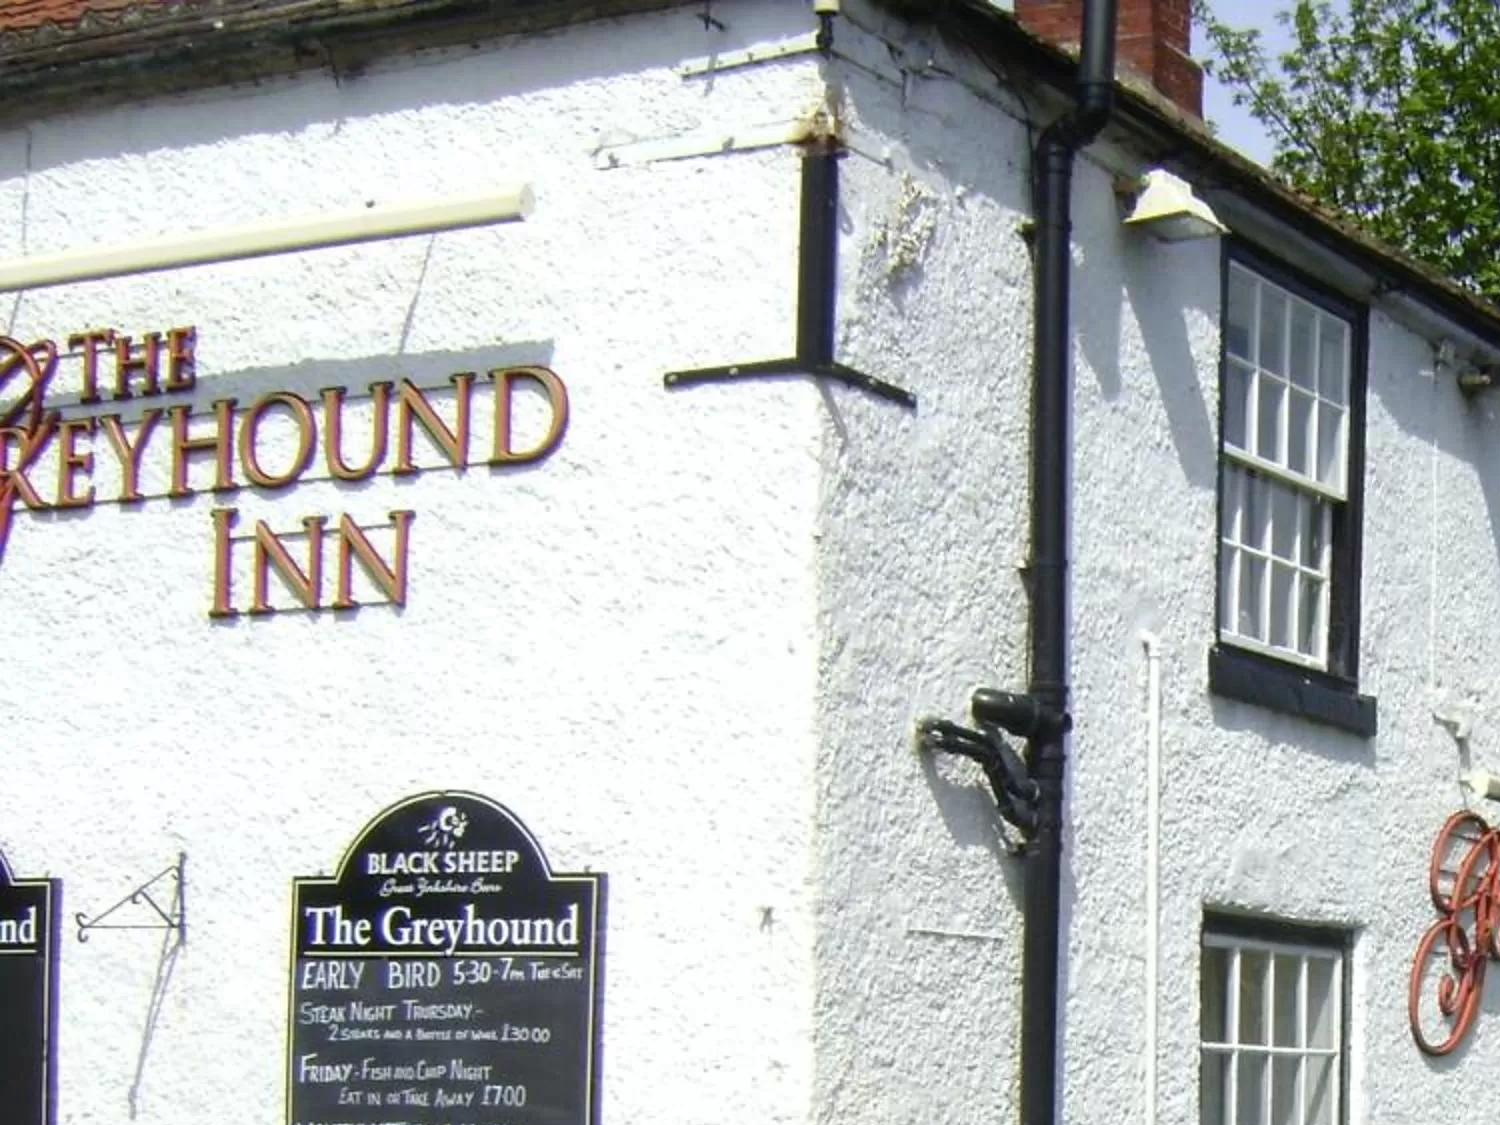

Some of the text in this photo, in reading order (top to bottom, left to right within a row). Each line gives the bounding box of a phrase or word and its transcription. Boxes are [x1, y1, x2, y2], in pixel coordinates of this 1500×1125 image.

[68, 327, 197, 403] THE
[209, 507, 415, 616] INN
[367, 850, 520, 875] BLACK SHEEP
[304, 903, 579, 955] The Greyhound
[301, 960, 365, 990] EARLY
[388, 960, 441, 989] BIRD
[300, 1001, 346, 1025] STEAK
[349, 1000, 397, 1021] NIGHT
[449, 1057, 493, 1081] NIGHT
[433, 1088, 475, 1108] AWAY
